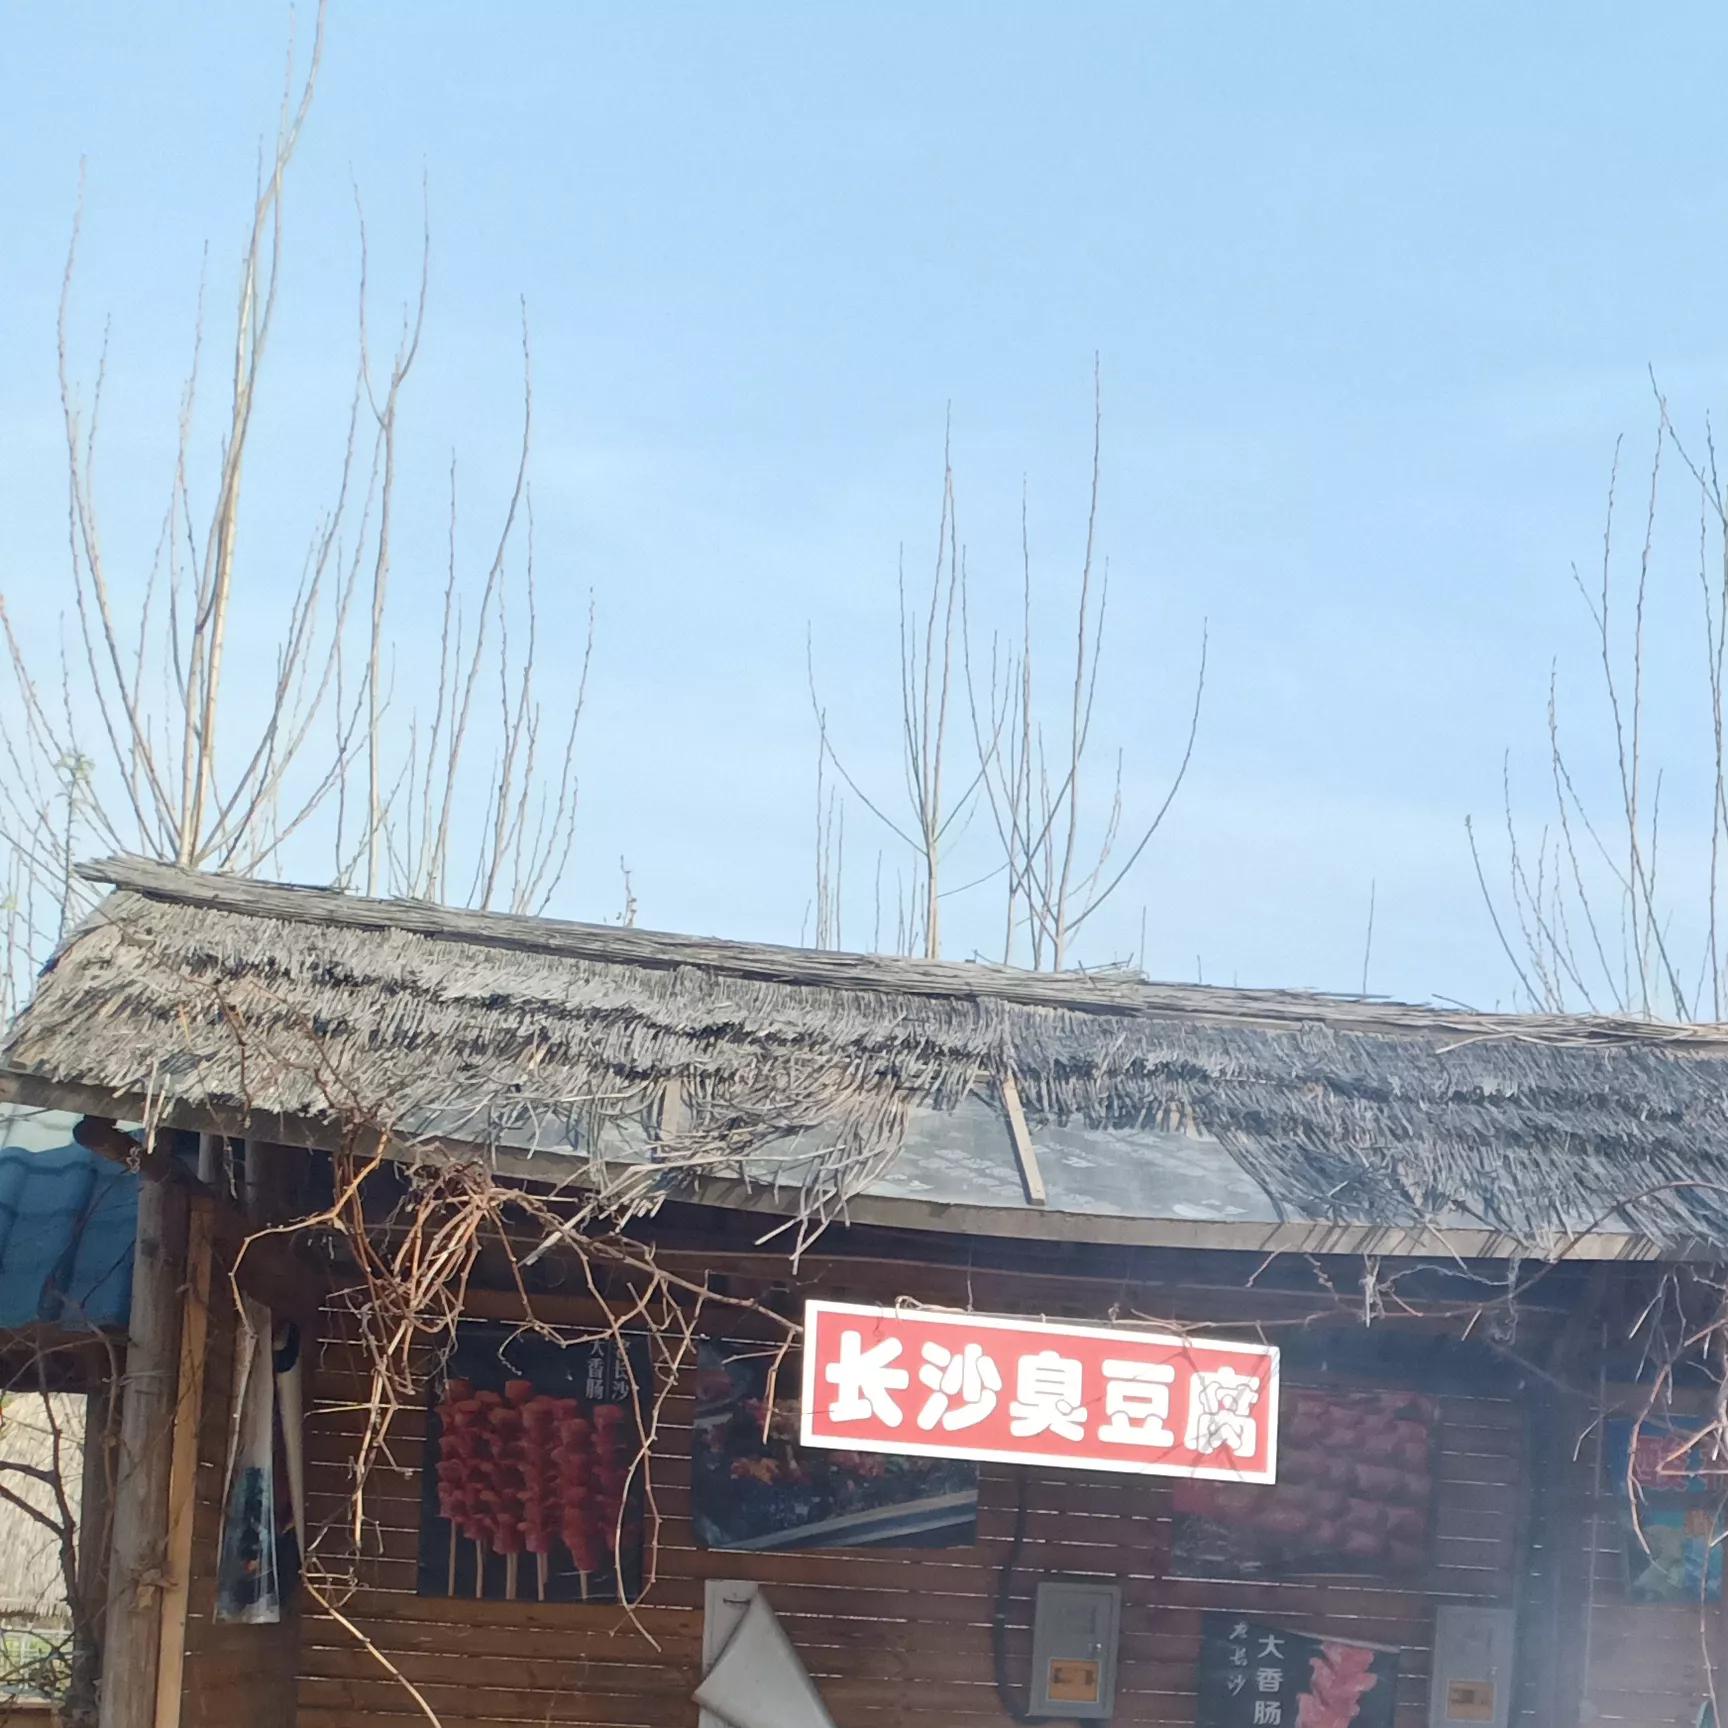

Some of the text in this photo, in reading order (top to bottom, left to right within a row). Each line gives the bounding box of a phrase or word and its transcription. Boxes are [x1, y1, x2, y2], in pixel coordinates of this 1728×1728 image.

[824, 1329, 1259, 1458] 长沙臭豆腐
[1253, 1634, 1285, 1725] 大香肠
